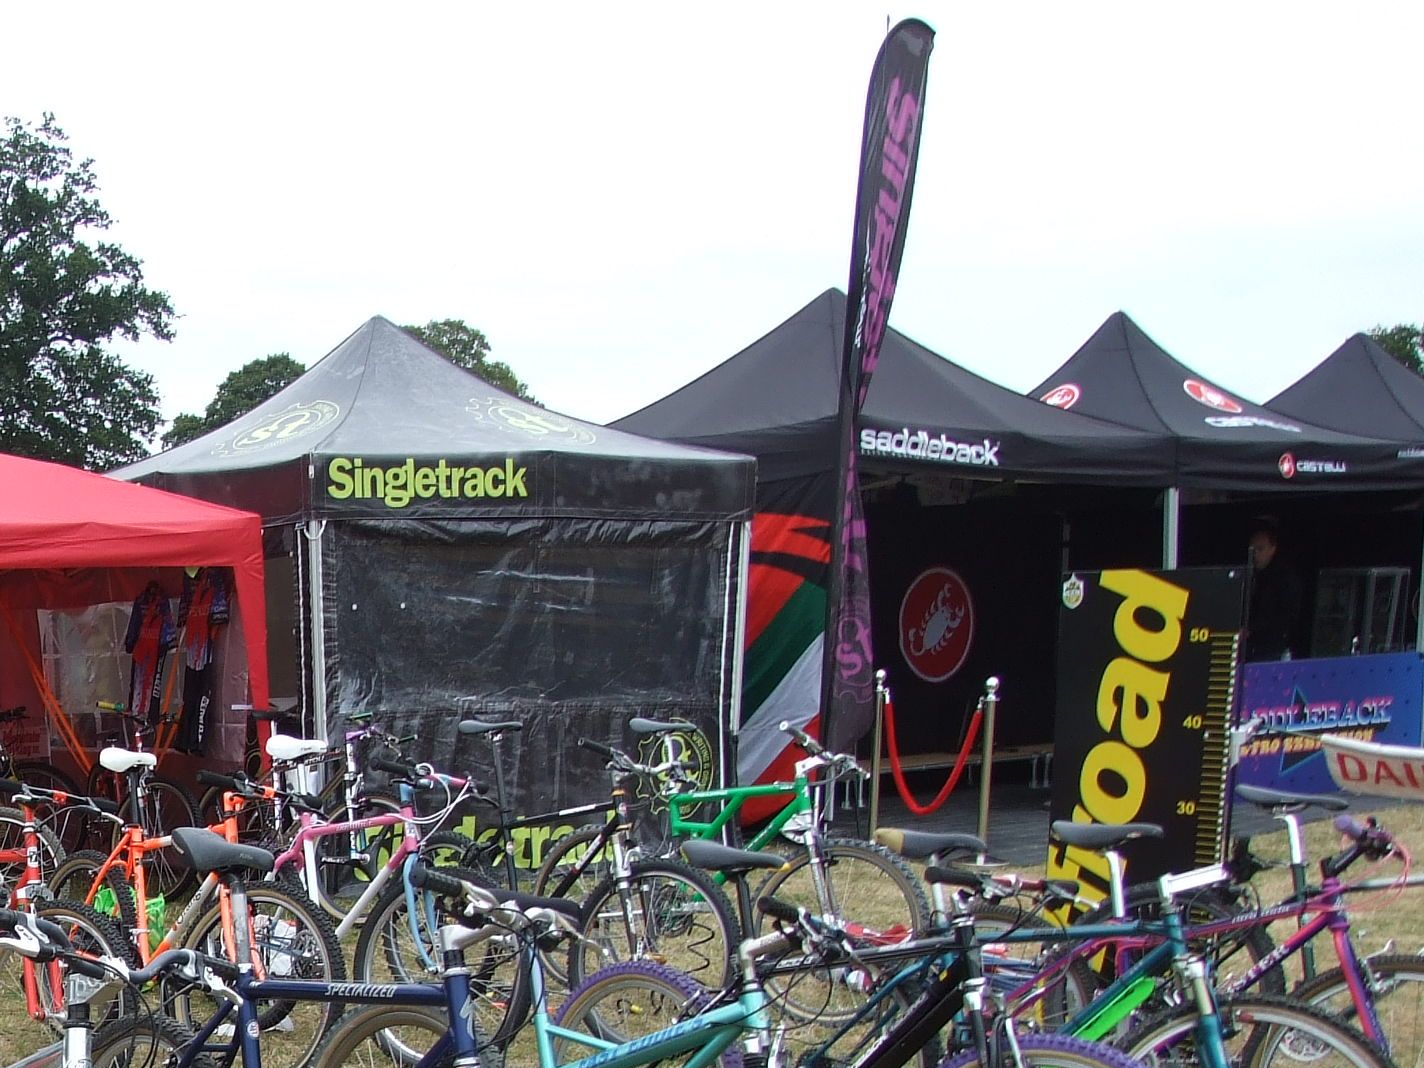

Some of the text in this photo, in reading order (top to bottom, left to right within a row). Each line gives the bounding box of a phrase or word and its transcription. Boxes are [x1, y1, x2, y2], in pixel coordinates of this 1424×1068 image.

[860, 428, 1000, 466] saddleback
[328, 458, 528, 508] Singletrack
[1189, 628, 1209, 642] 50
[1182, 715, 1202, 729] 40
[1176, 801, 1196, 815] 30
[325, 983, 397, 998] SPECIALIZED
